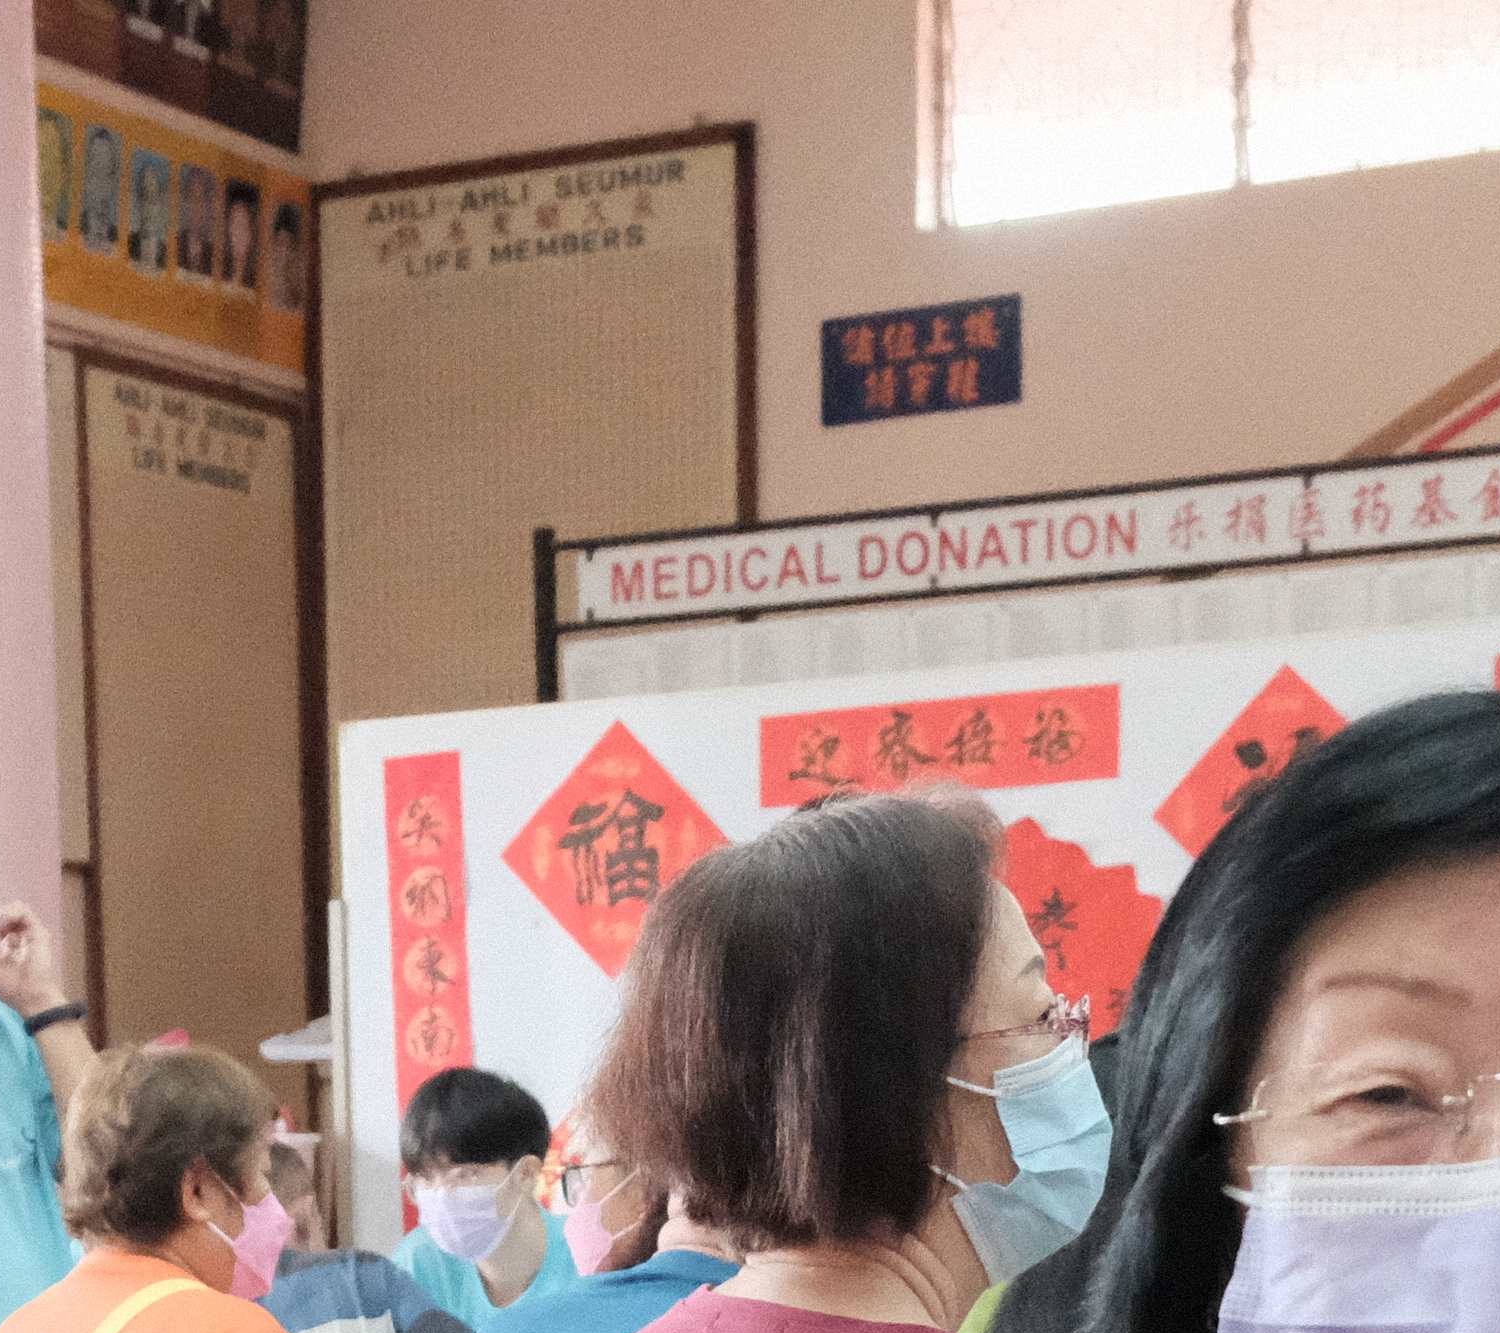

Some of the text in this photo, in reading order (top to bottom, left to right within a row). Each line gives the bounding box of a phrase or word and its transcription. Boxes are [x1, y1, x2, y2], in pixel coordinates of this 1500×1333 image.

[554, 158, 686, 199] SEUMUR
[404, 249, 473, 277] LIFE
[488, 223, 646, 266] MEMBERS
[609, 510, 1139, 605] MEDICAL DONATION
